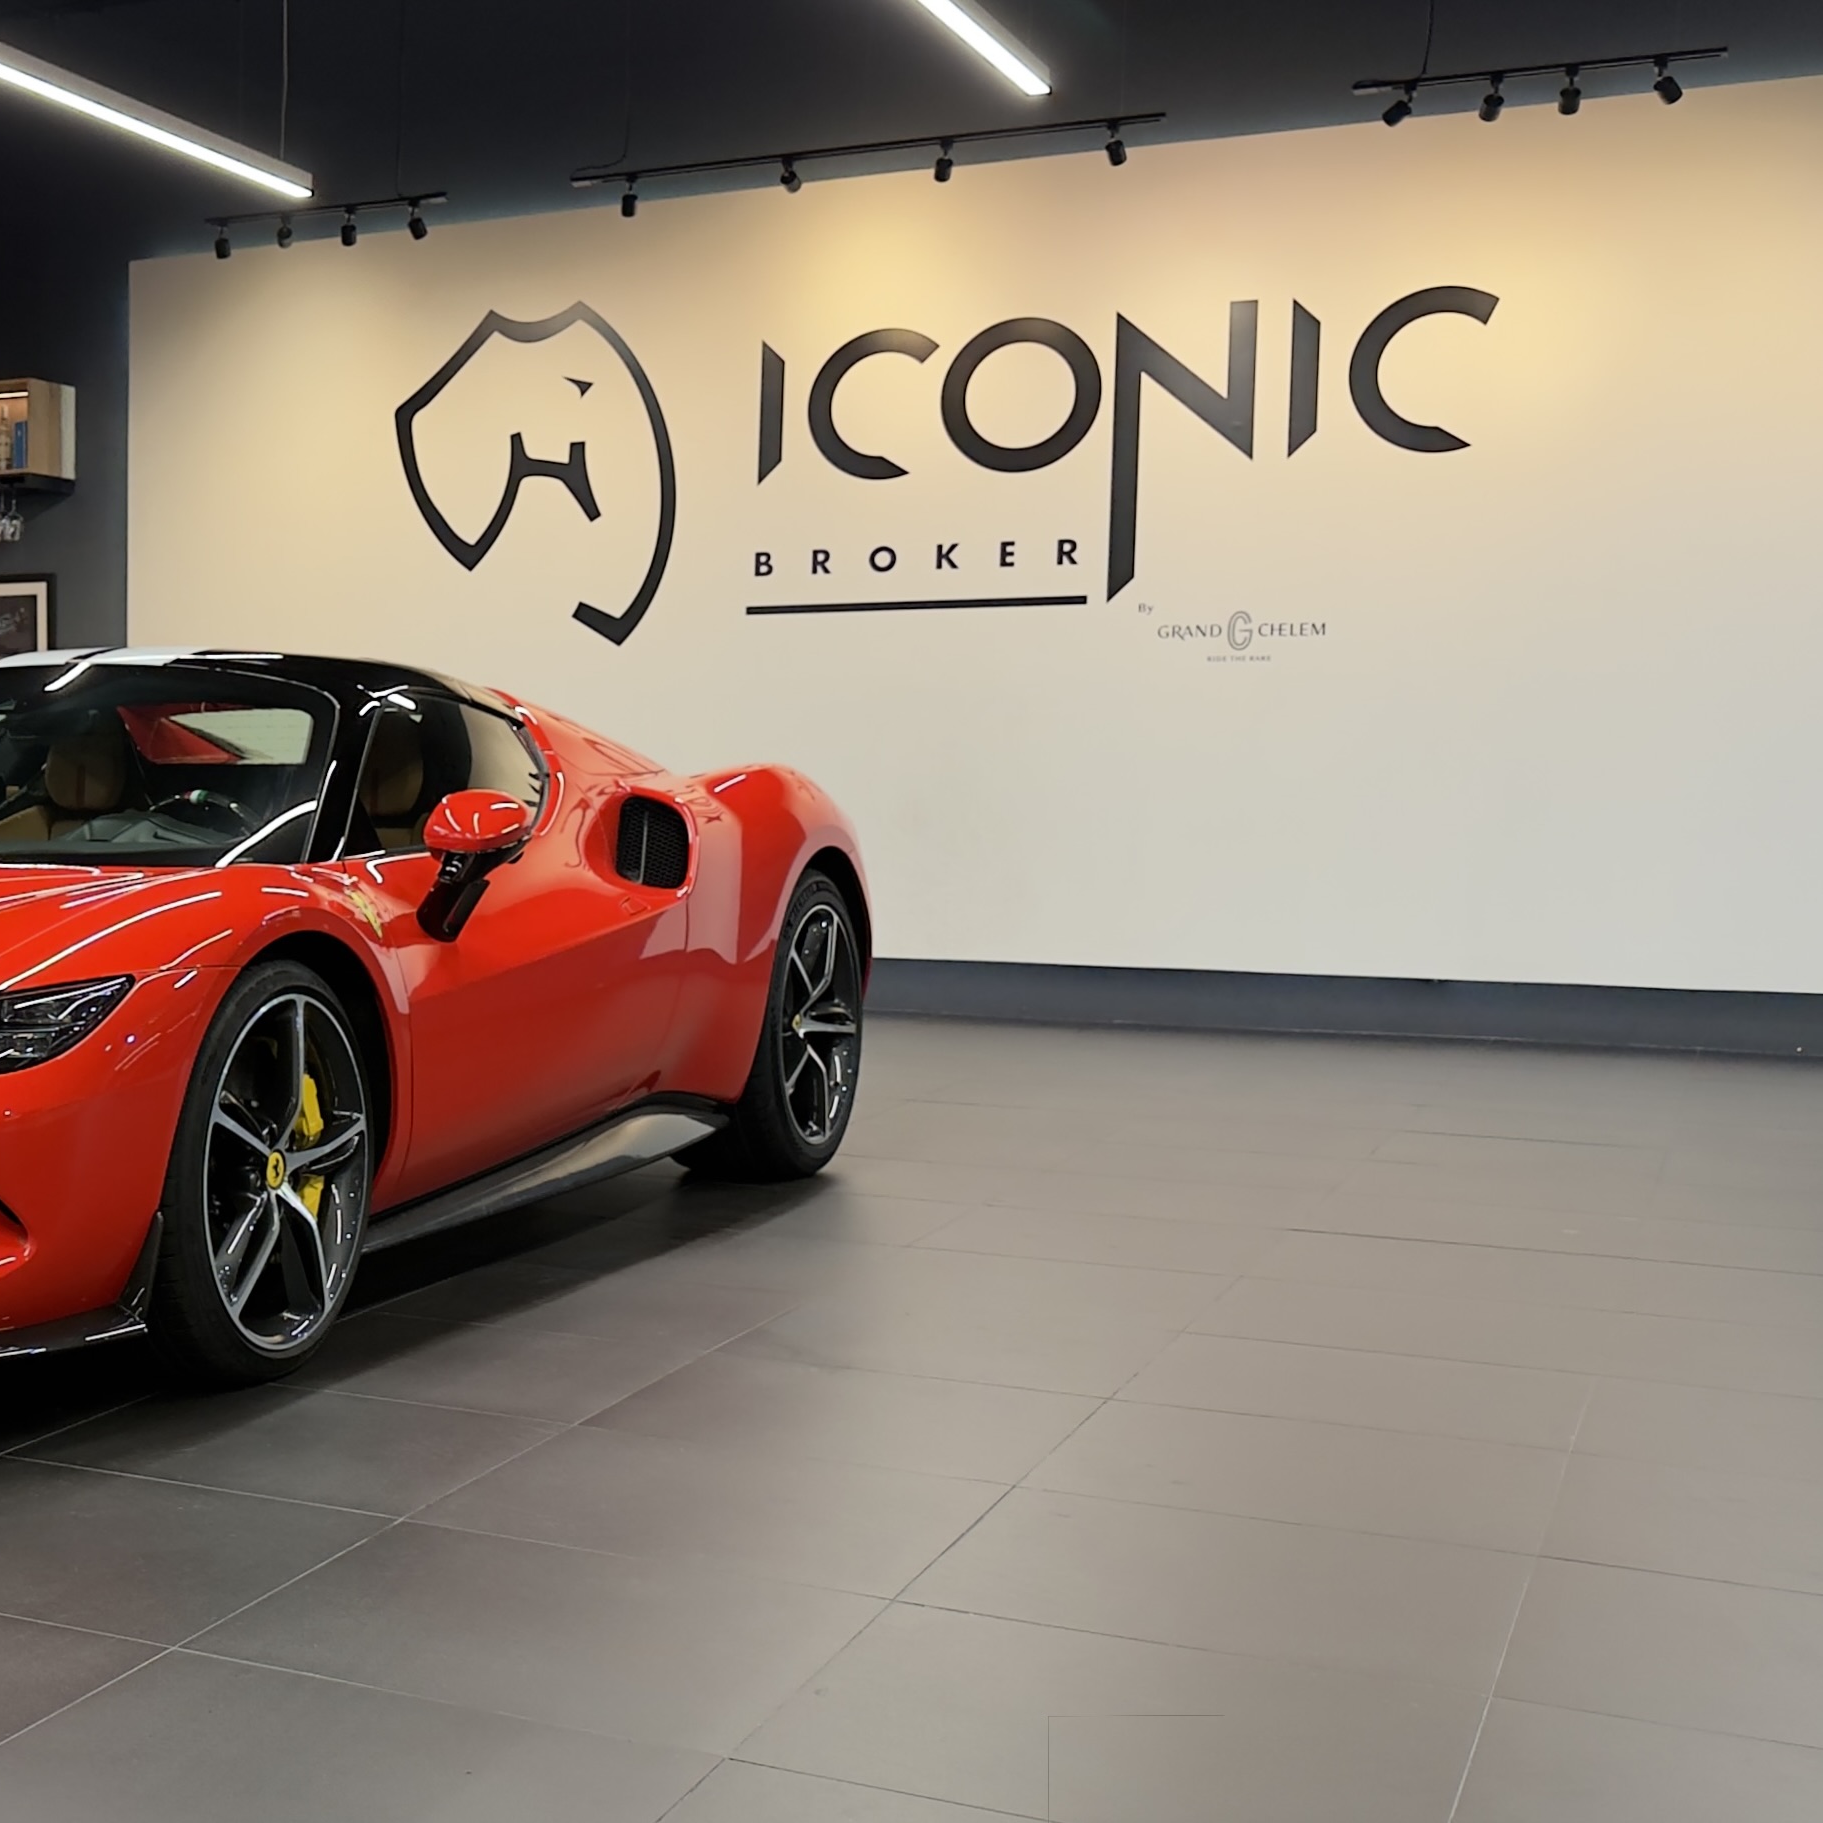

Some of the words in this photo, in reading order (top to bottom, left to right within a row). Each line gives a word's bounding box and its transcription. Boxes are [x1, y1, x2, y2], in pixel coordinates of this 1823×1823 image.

[757, 285, 1499, 602] ICONIC
[753, 538, 1079, 577] BROKER
[1137, 603, 1154, 615] By
[1157, 624, 1223, 641] GRAND
[1257, 622, 1327, 637] CHELEM
